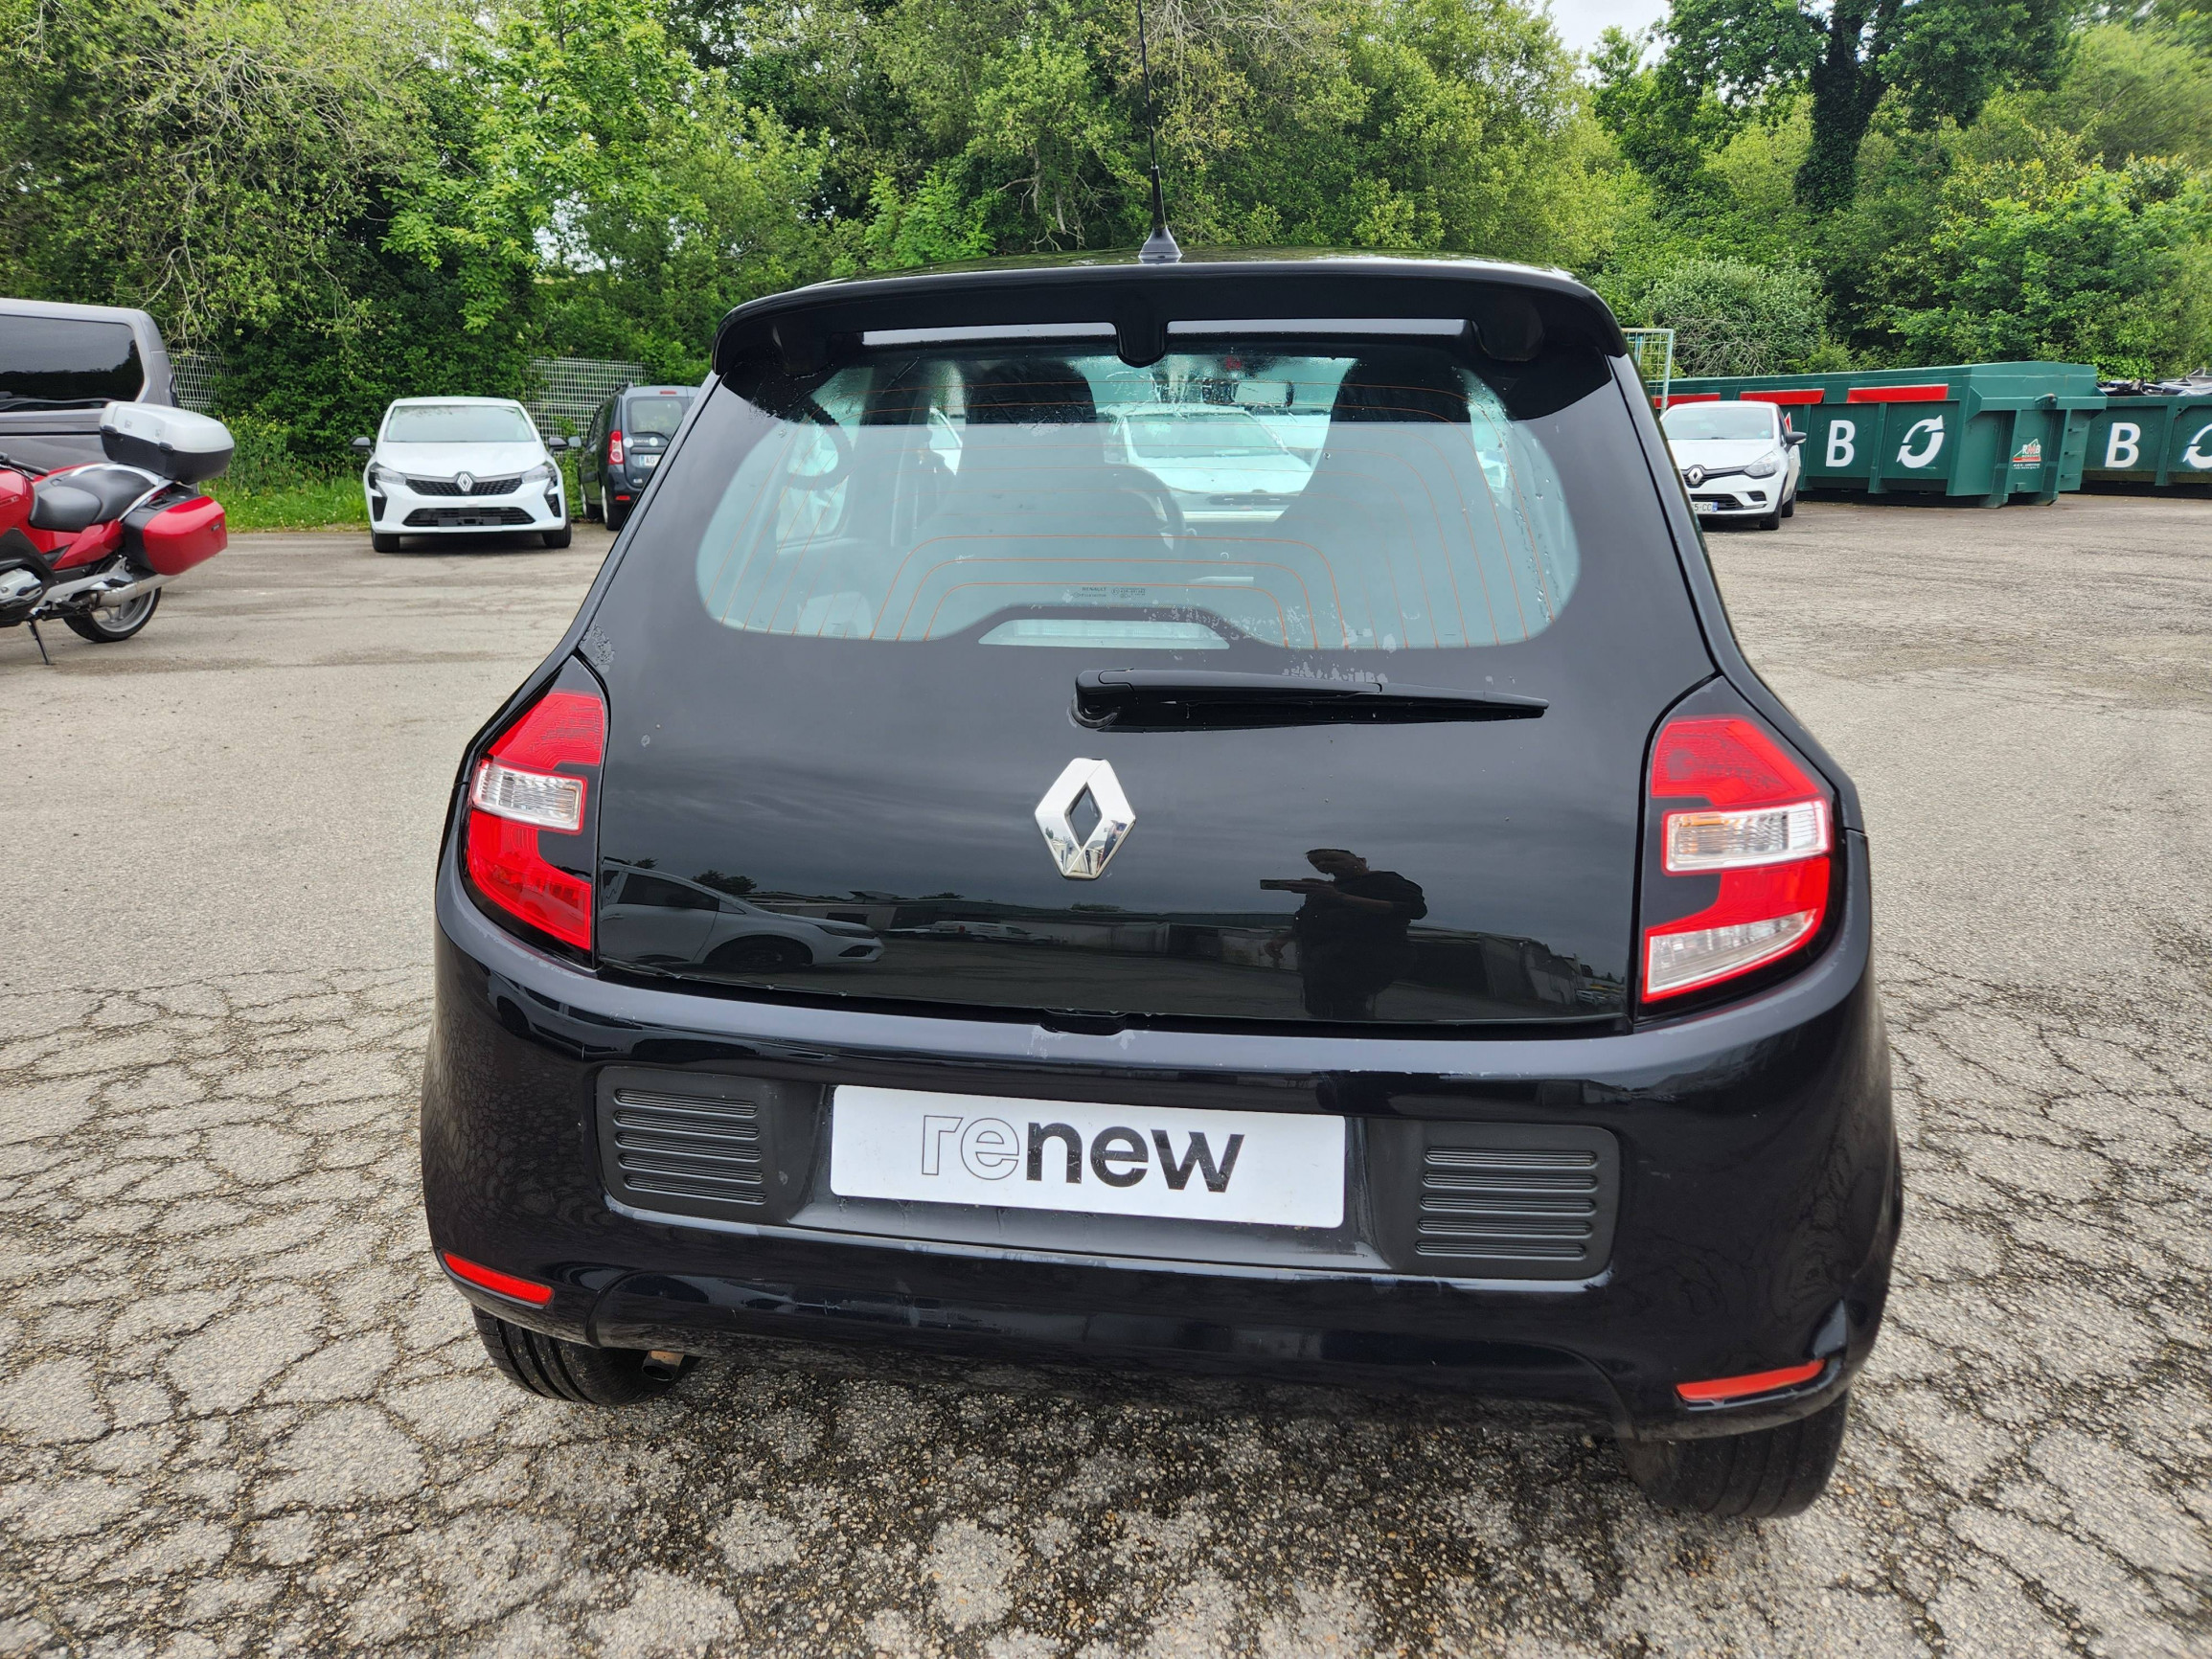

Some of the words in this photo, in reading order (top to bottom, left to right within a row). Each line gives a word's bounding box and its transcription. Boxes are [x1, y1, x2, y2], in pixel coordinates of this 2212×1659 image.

[1825, 420, 1856, 467] B
[2105, 421, 2141, 467] B
[1692, 503, 1712, 511] 5-CC
[922, 1115, 1245, 1193] renew
